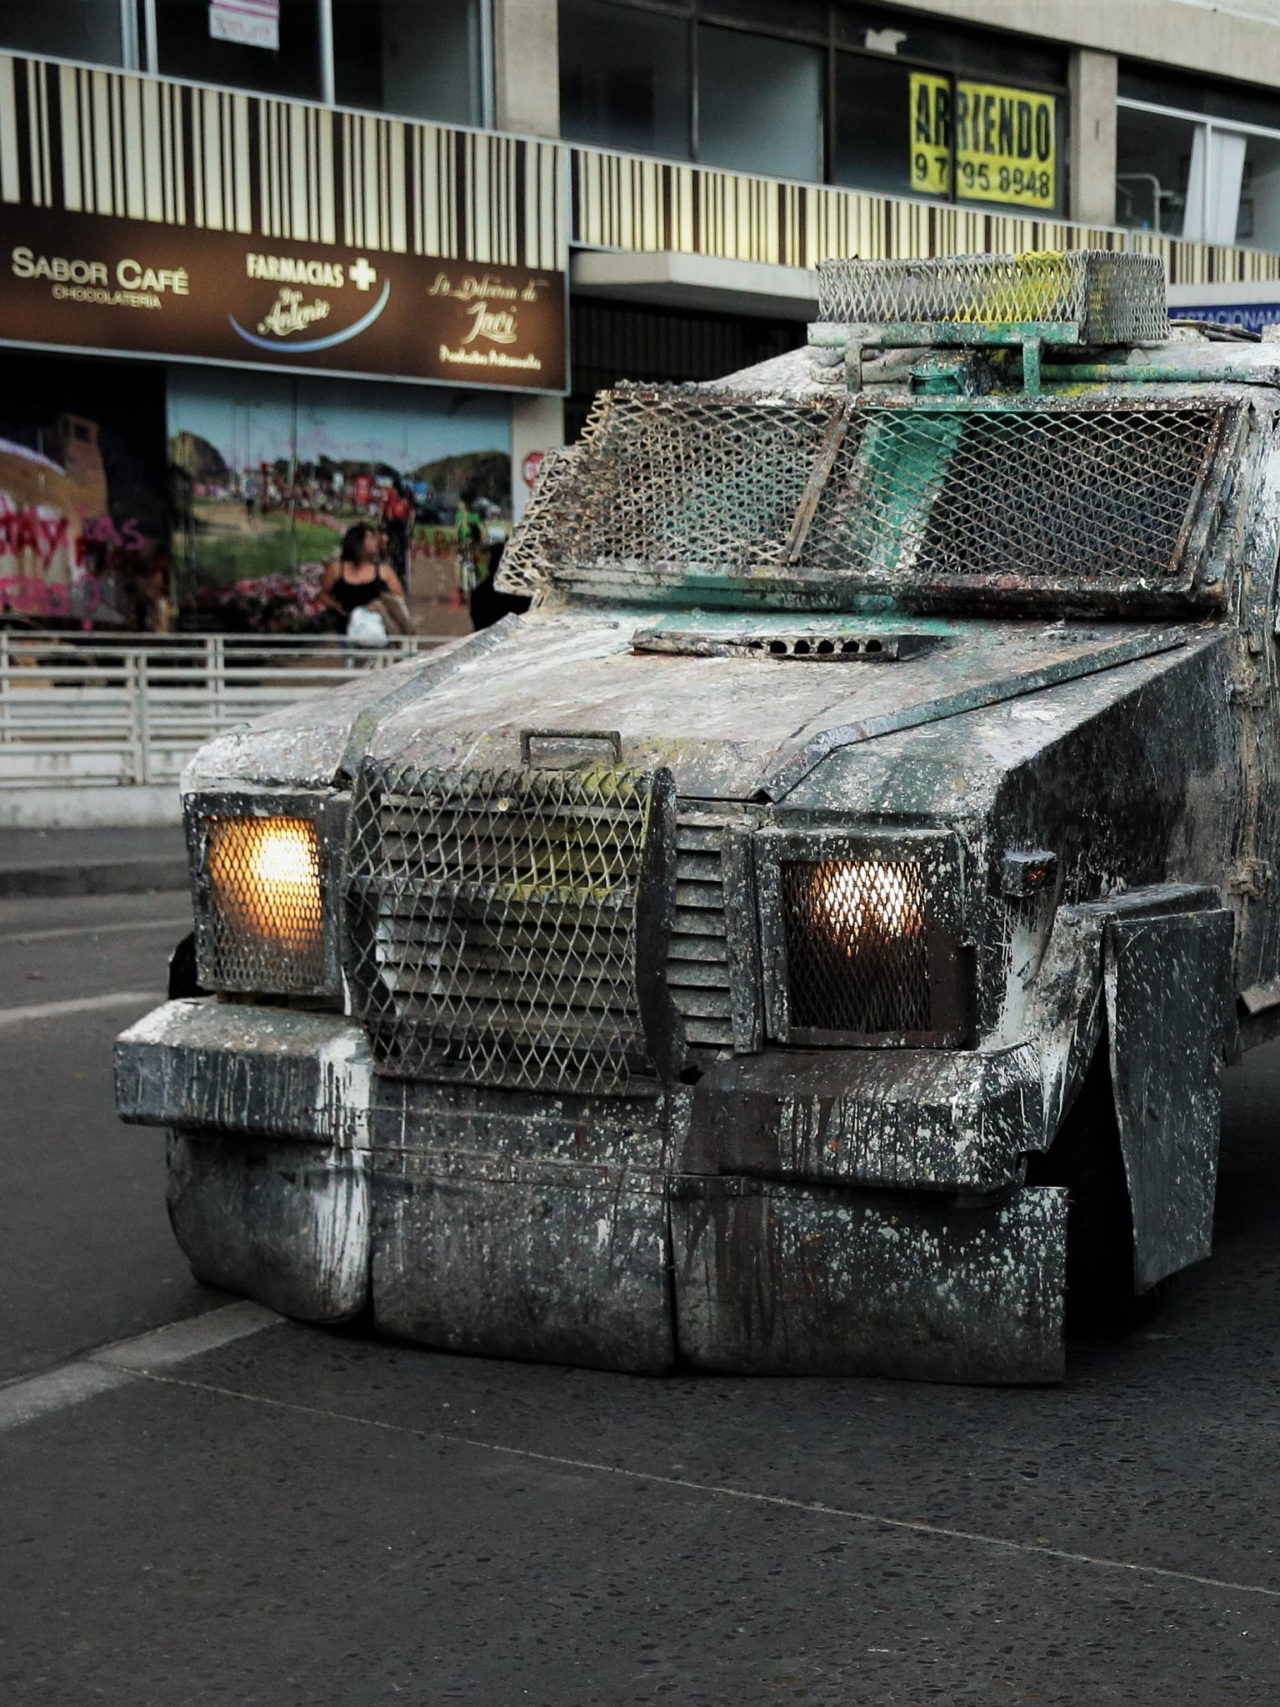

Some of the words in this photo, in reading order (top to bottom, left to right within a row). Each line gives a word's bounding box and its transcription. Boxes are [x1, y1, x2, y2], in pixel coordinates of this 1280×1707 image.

[916, 83, 1051, 162] ARRIENDO
[914, 153, 928, 181] 9
[12, 246, 109, 286] SABOR
[116, 258, 190, 295] CAFÉ
[246, 252, 345, 288] FARMACIAS
